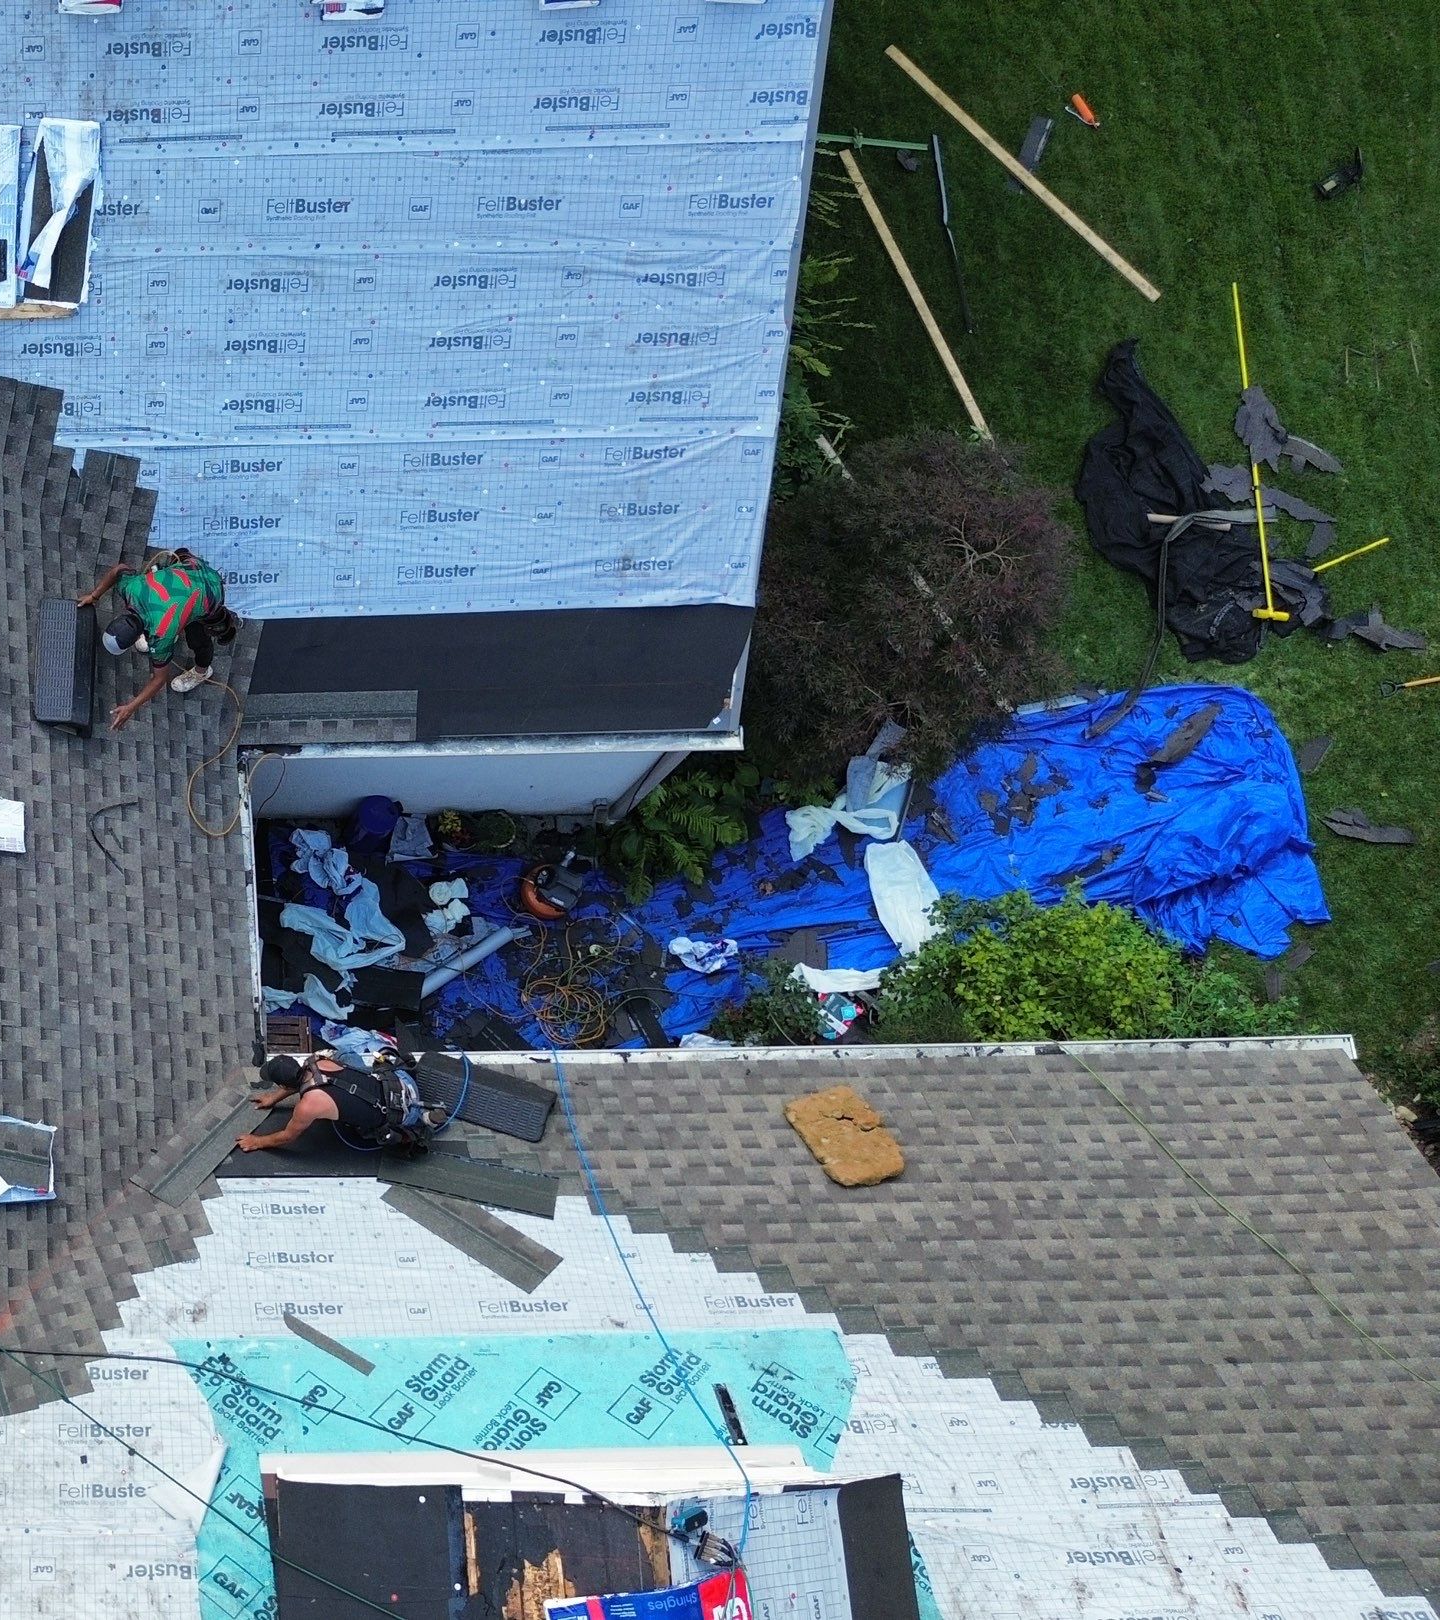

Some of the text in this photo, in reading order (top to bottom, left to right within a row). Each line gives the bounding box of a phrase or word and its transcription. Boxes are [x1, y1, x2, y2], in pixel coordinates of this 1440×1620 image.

[323, 33, 408, 50] FeltBuster
[540, 26, 626, 44] FeltBuster
[105, 40, 190, 56] FeltBuster
[320, 101, 404, 117] FeltBuster
[534, 94, 619, 112] FeltBuster
[106, 106, 190, 121] FeltBuster
[267, 198, 351, 213] FeltBuster
[477, 197, 561, 212] FeltBuster
[689, 194, 775, 209] FeltBuster
[226, 277, 309, 292] FeltBuster
[434, 273, 517, 289] FeltBuster
[642, 269, 724, 285] FeltBuster
[225, 337, 306, 352] FeltBuster
[430, 333, 512, 348] FeltBuster
[636, 329, 717, 345] FeltBuster
[21, 340, 100, 355] FeltBuster
[426, 393, 506, 408] FeltBuster
[628, 389, 710, 404] FeltBuster
[222, 397, 303, 413] FeltBuster
[403, 451, 483, 468] FeltBuster
[605, 446, 686, 461] FeltBuster
[203, 458, 282, 475] FeltBuster
[203, 515, 281, 530] FeltBuster
[400, 509, 479, 525] FeltBuster
[397, 565, 475, 580] FeltBuster
[595, 557, 675, 573] FeltBuster
[243, 1203, 325, 1215] FeltBuster
[479, 1299, 568, 1314] FeltBuster
[706, 1294, 794, 1309] FeltBuster
[404, 1353, 451, 1394] Storm
[420, 1356, 471, 1402] Guard
[433, 1367, 478, 1410] Leak Barrier
[535, 1381, 563, 1408] GAF
[625, 1397, 653, 1425] GAF
[750, 1381, 818, 1427] Guard
[222, 1393, 281, 1440] Guard
[388, 1402, 415, 1430] GAF
[751, 1395, 812, 1440] Storm
[213, 1402, 269, 1447] Leak Barrier
[1071, 1474, 1169, 1490] FeltBuster
[213, 1572, 250, 1601] GAF
[648, 1593, 698, 1611] Shingles
